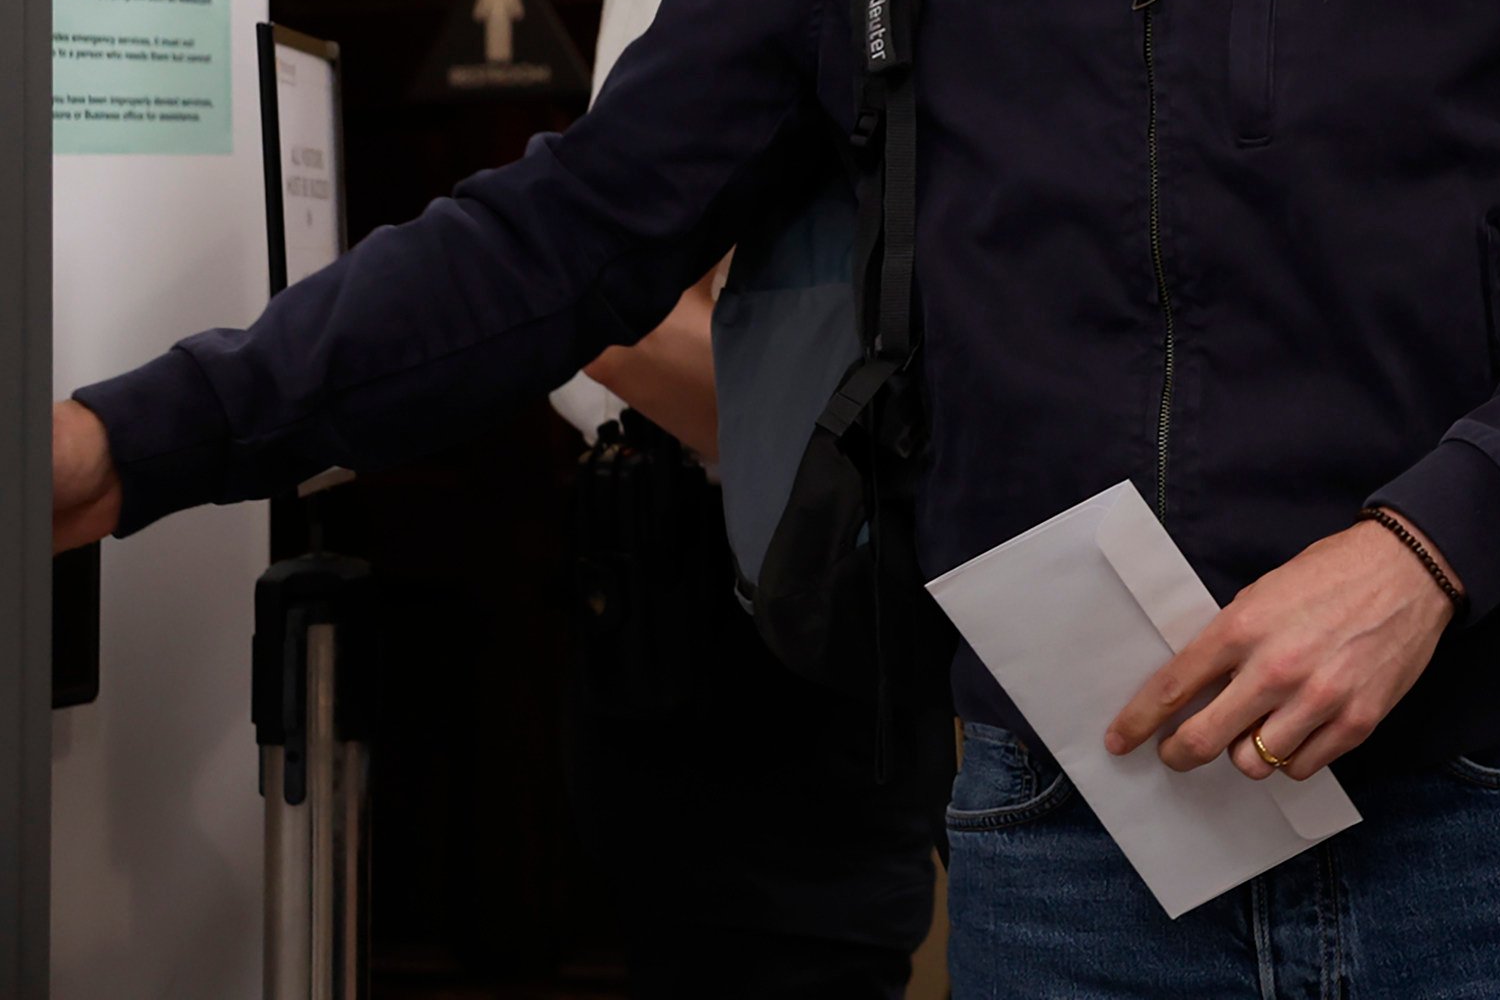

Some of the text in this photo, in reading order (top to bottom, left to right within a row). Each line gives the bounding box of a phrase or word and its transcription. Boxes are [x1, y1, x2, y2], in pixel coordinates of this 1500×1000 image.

[71, 34, 116, 47] emergency
[67, 93, 86, 104] have
[88, 94, 107, 104] been
[84, 109, 121, 121] Business
